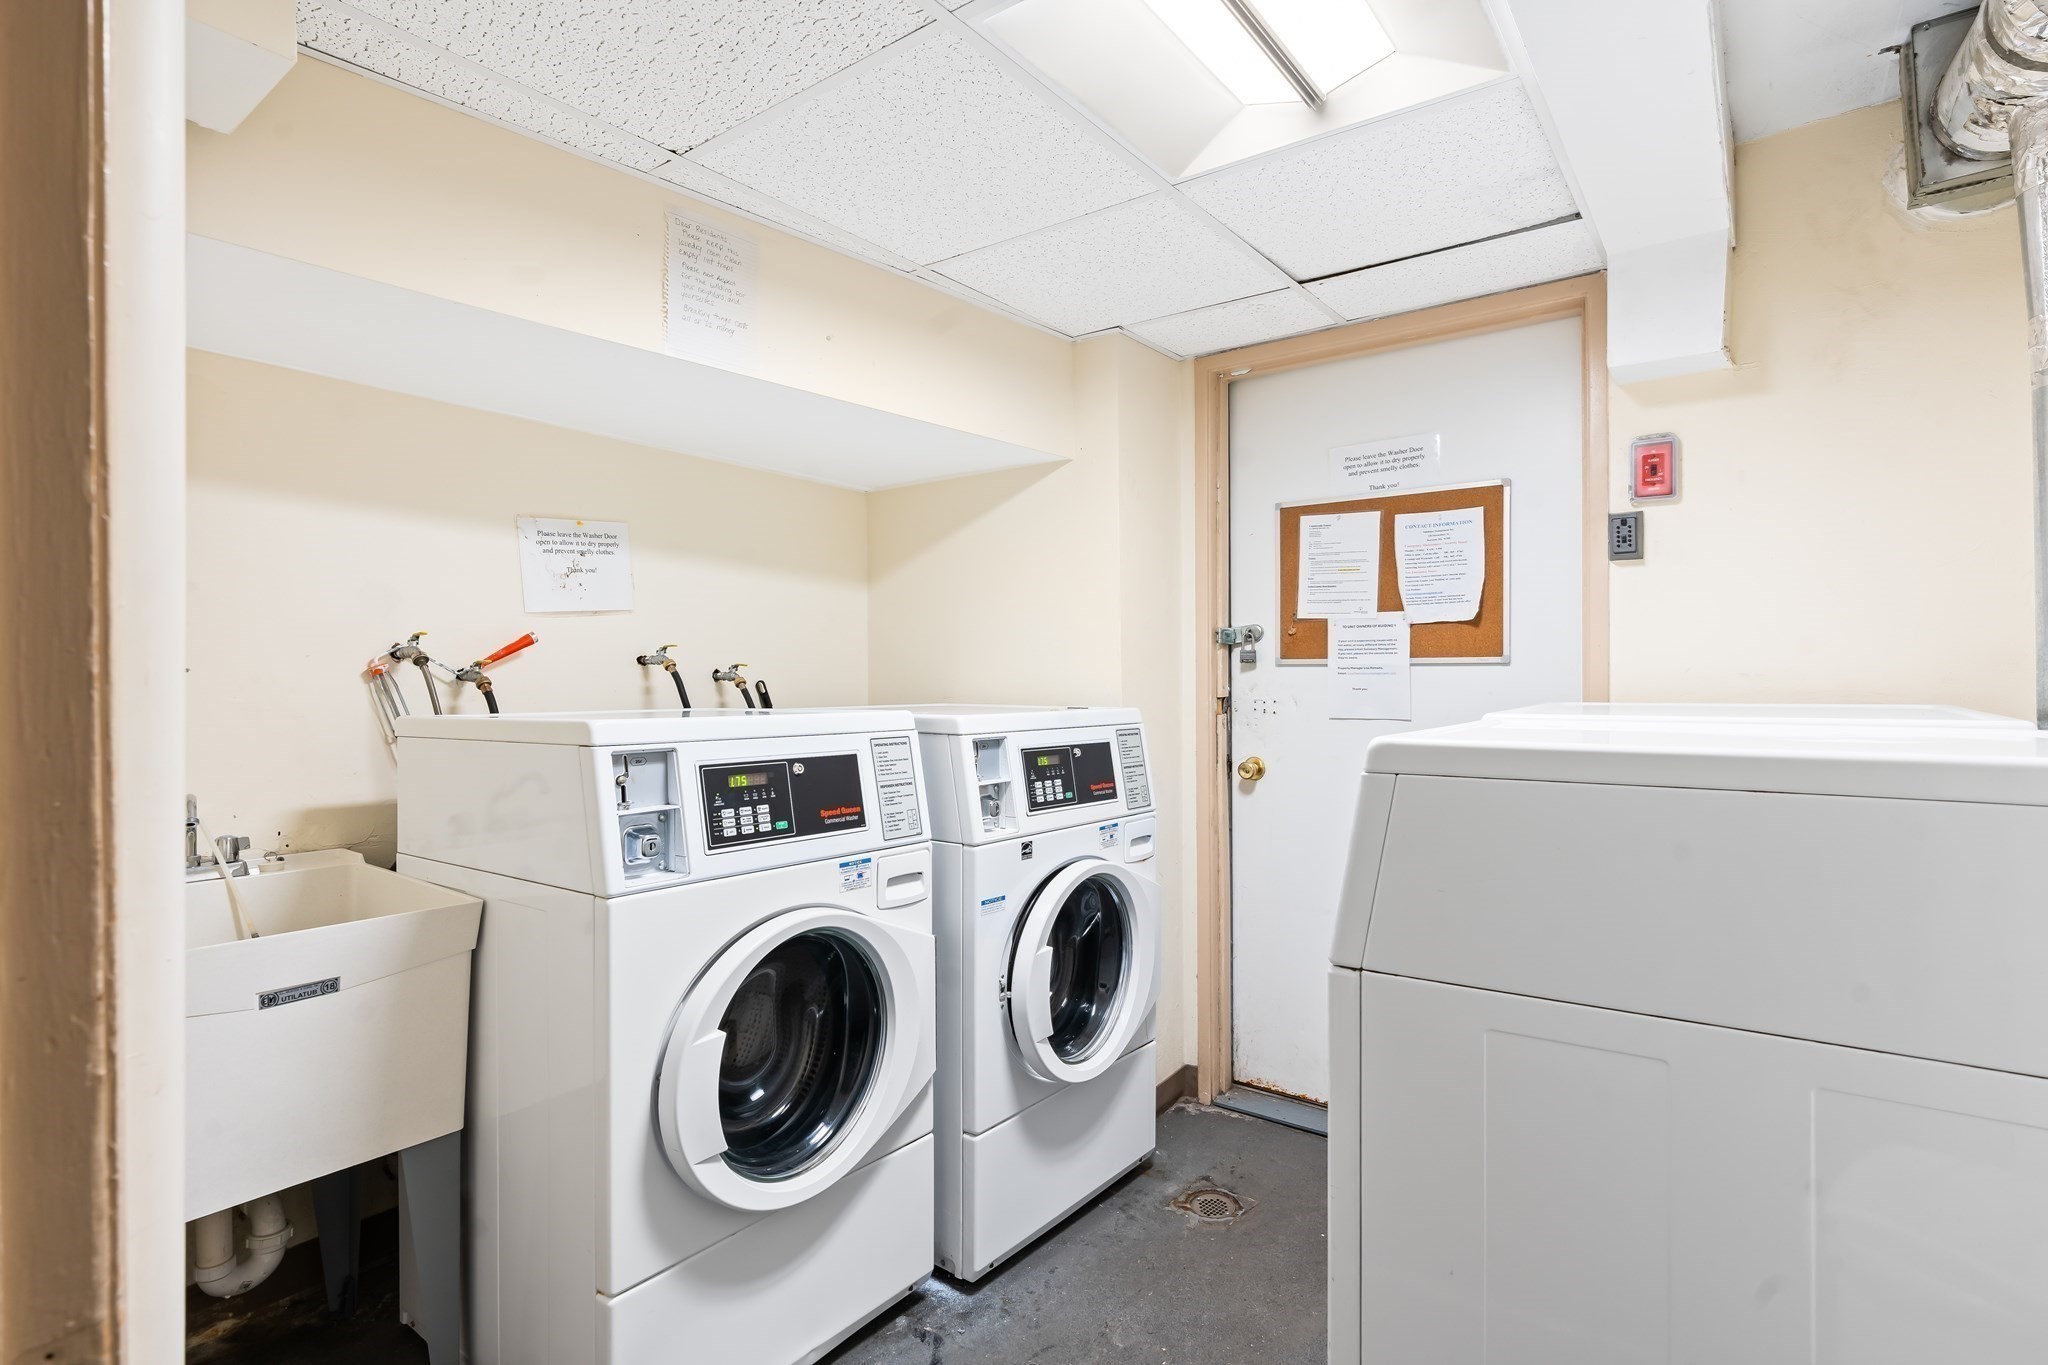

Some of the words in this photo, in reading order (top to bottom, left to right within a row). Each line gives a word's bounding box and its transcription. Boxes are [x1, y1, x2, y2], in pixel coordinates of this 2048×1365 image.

[675, 218, 691, 229] Dear
[682, 229, 700, 241] Please
[678, 238, 702, 256] laundry
[682, 262, 700, 274] Please
[1402, 454, 1425, 462] properly
[1359, 468, 1379, 476] prevent
[1432, 520, 1473, 528] INFORMATION
[820, 807, 840, 818] Speed
[841, 806, 861, 814] Queen
[824, 816, 845, 825] Commercial
[325, 982, 336, 991] 18
[281, 990, 318, 1002] UTILATUB
